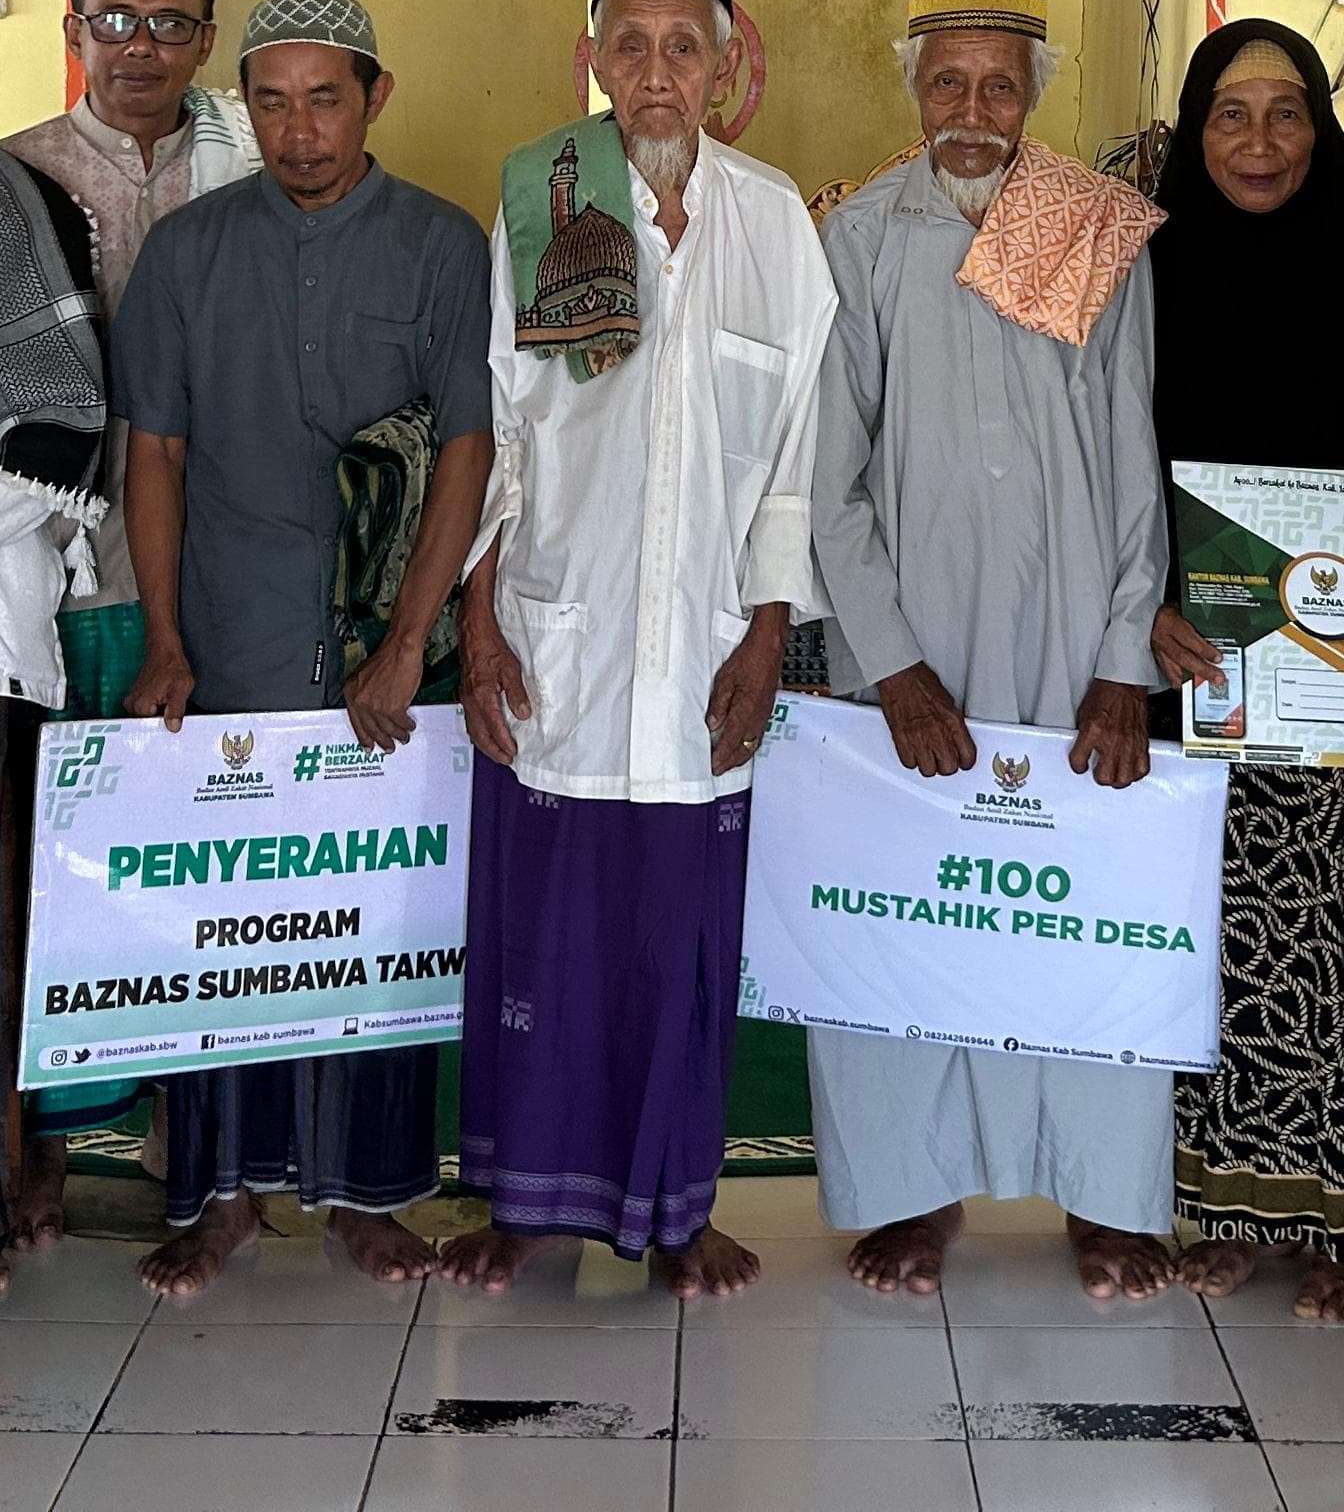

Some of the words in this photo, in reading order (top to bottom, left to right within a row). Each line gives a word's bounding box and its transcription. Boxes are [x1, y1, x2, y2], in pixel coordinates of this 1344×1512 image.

[324, 752, 385, 767] BERZAKAT
[326, 743, 366, 754] NIKMA
[207, 772, 264, 786] BAZNAS
[976, 793, 1042, 810] BAZNAS
[108, 824, 449, 891] PENYERAHAN
[937, 853, 1072, 903] #100
[195, 907, 361, 949] PROGRAM
[811, 884, 1001, 932] MUSTAHIK
[1011, 910, 1083, 942] PER
[1094, 918, 1197, 954] DESA
[45, 974, 189, 1016] BAZNAS
[196, 958, 367, 1001] SUMBAWA
[217, 1033, 251, 1045] baznas
[272, 1026, 315, 1040] sumbawa
